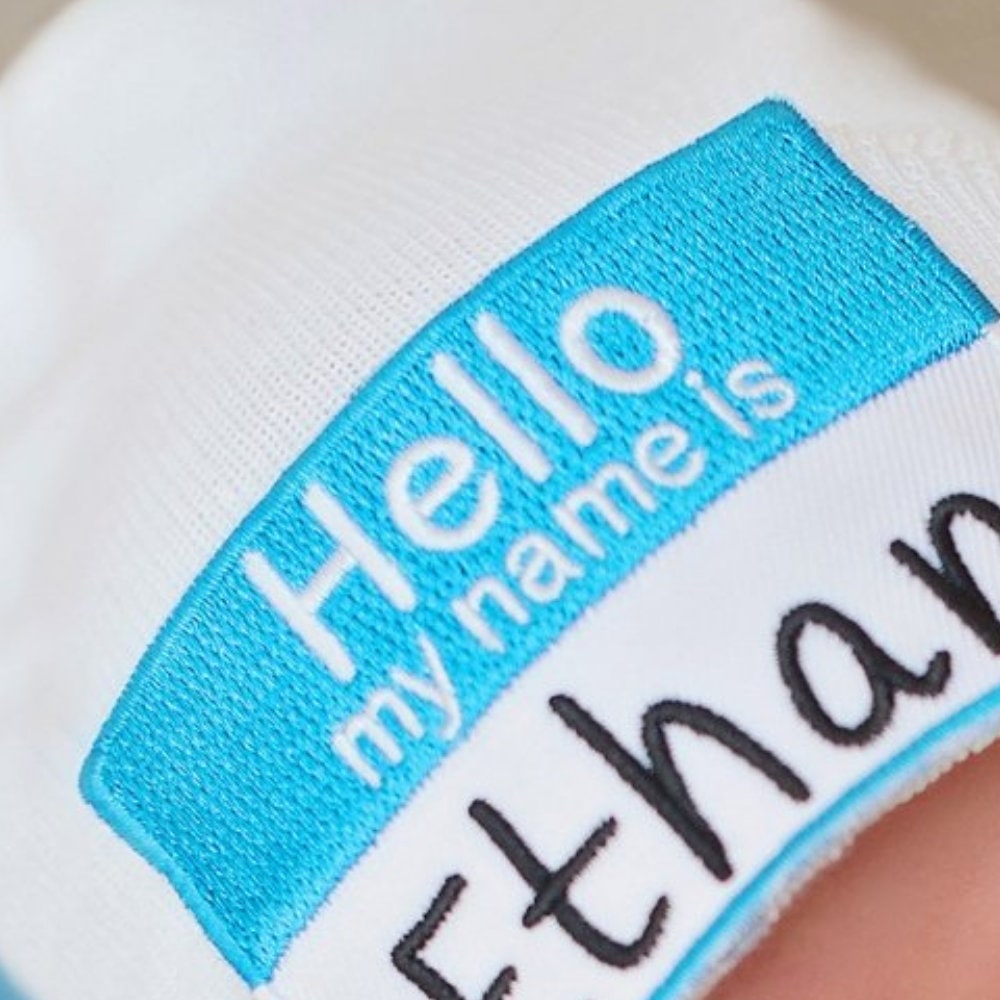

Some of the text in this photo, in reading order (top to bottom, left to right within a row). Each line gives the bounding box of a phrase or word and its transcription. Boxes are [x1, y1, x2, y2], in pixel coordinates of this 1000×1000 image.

[241, 285, 683, 682] Hello
[328, 357, 798, 788] my name is
